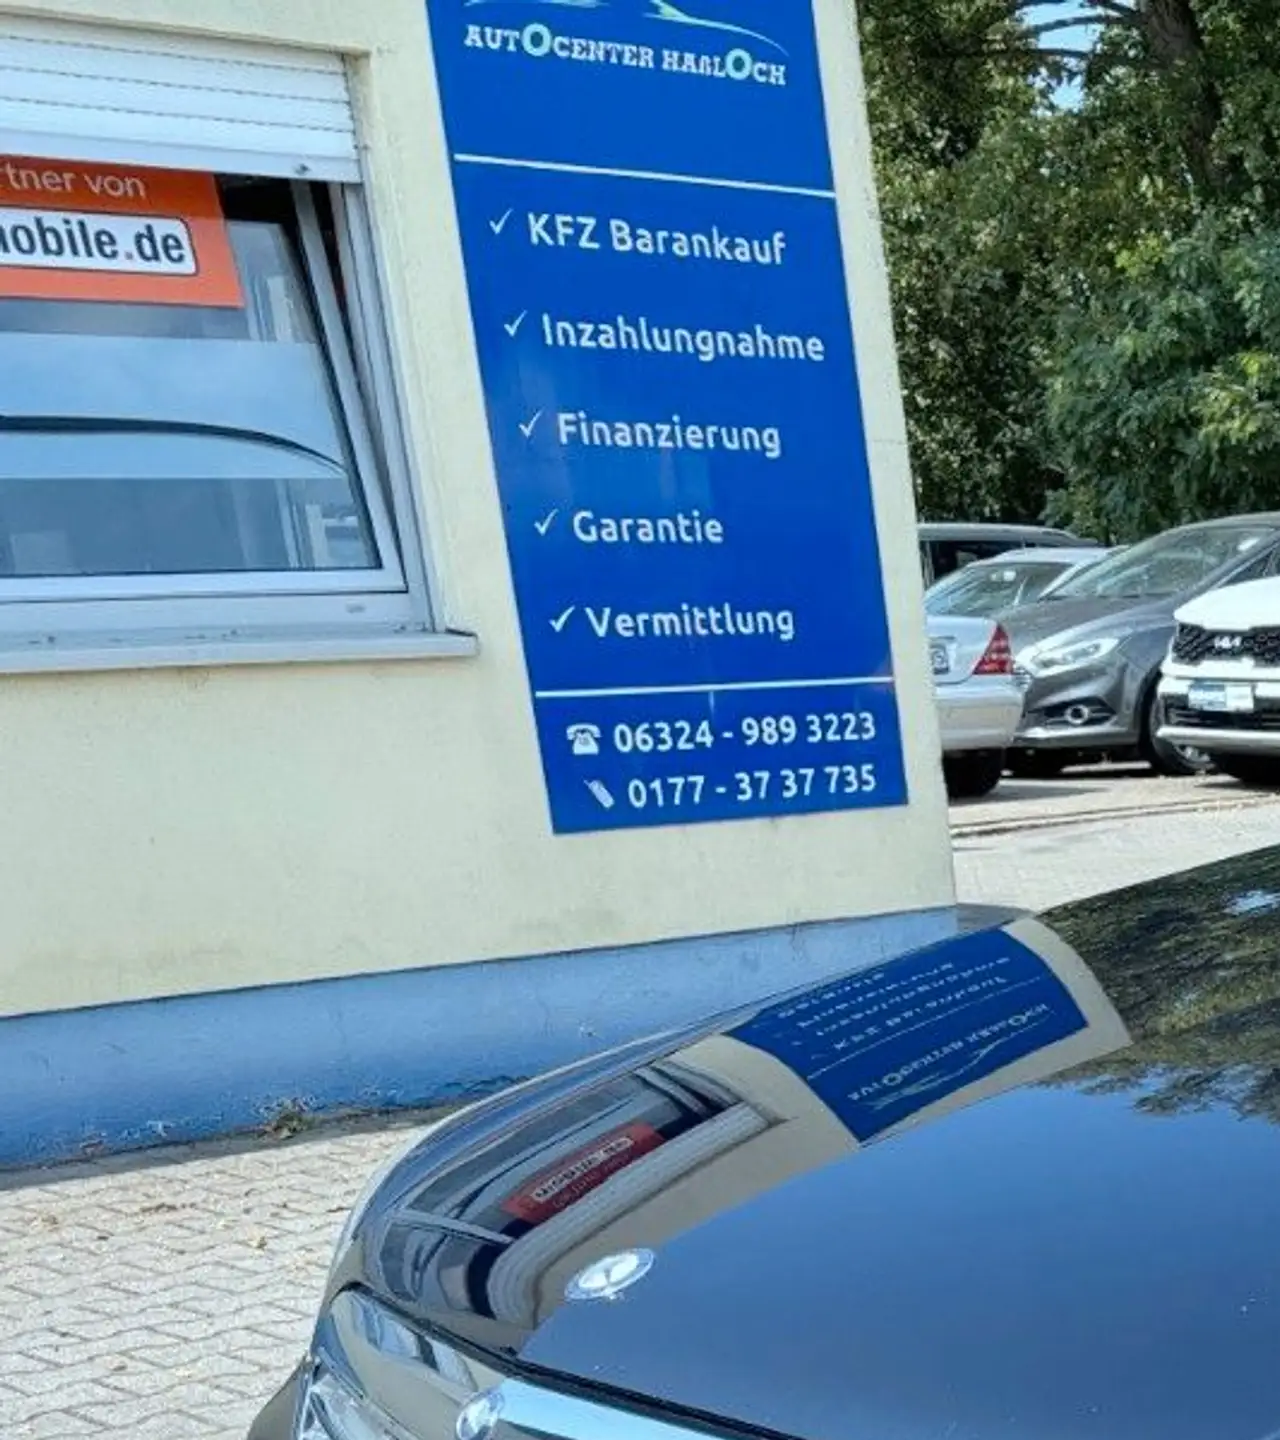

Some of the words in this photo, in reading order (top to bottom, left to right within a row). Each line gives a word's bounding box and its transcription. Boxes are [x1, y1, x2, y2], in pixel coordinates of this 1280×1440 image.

[464, 22, 654, 69] AUTOCENTER
[83, 173, 147, 198] von
[527, 212, 600, 250] KFZ
[609, 218, 786, 265] Barankauf
[541, 312, 825, 363] Inzahlungnahme
[556, 410, 782, 459] Finanzierung
[572, 509, 724, 543] Garantie
[584, 602, 796, 641] Vermittlung
[613, 719, 714, 753] 06324
[741, 714, 797, 746] 989
[805, 711, 876, 743] 3223
[627, 775, 704, 808] 0177
[734, 771, 770, 801] 37
[779, 767, 815, 798] 37
[823, 763, 877, 793] 735
